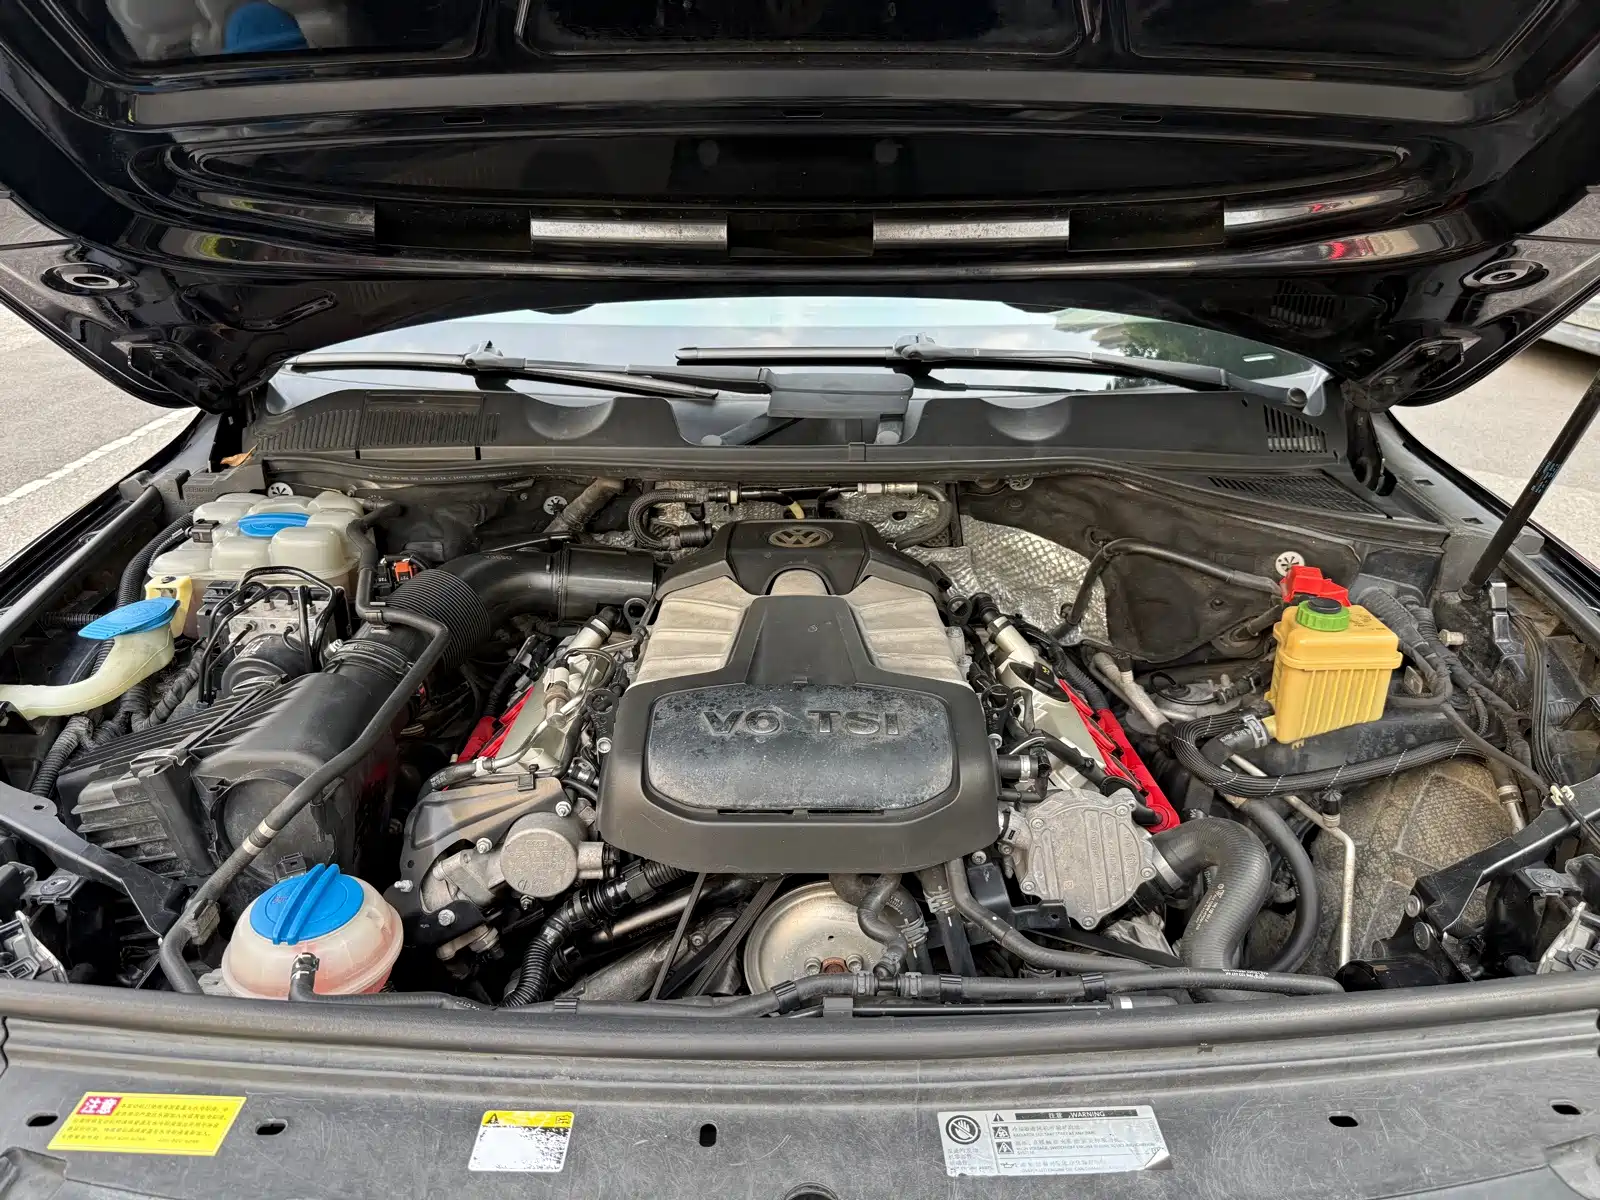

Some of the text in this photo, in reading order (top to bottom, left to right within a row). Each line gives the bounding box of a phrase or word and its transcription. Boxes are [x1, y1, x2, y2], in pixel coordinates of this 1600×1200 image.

[703, 709, 899, 736] V6 TSI
[80, 1097, 118, 1114] 注意
[1069, 1110, 1105, 1118] WARNING
